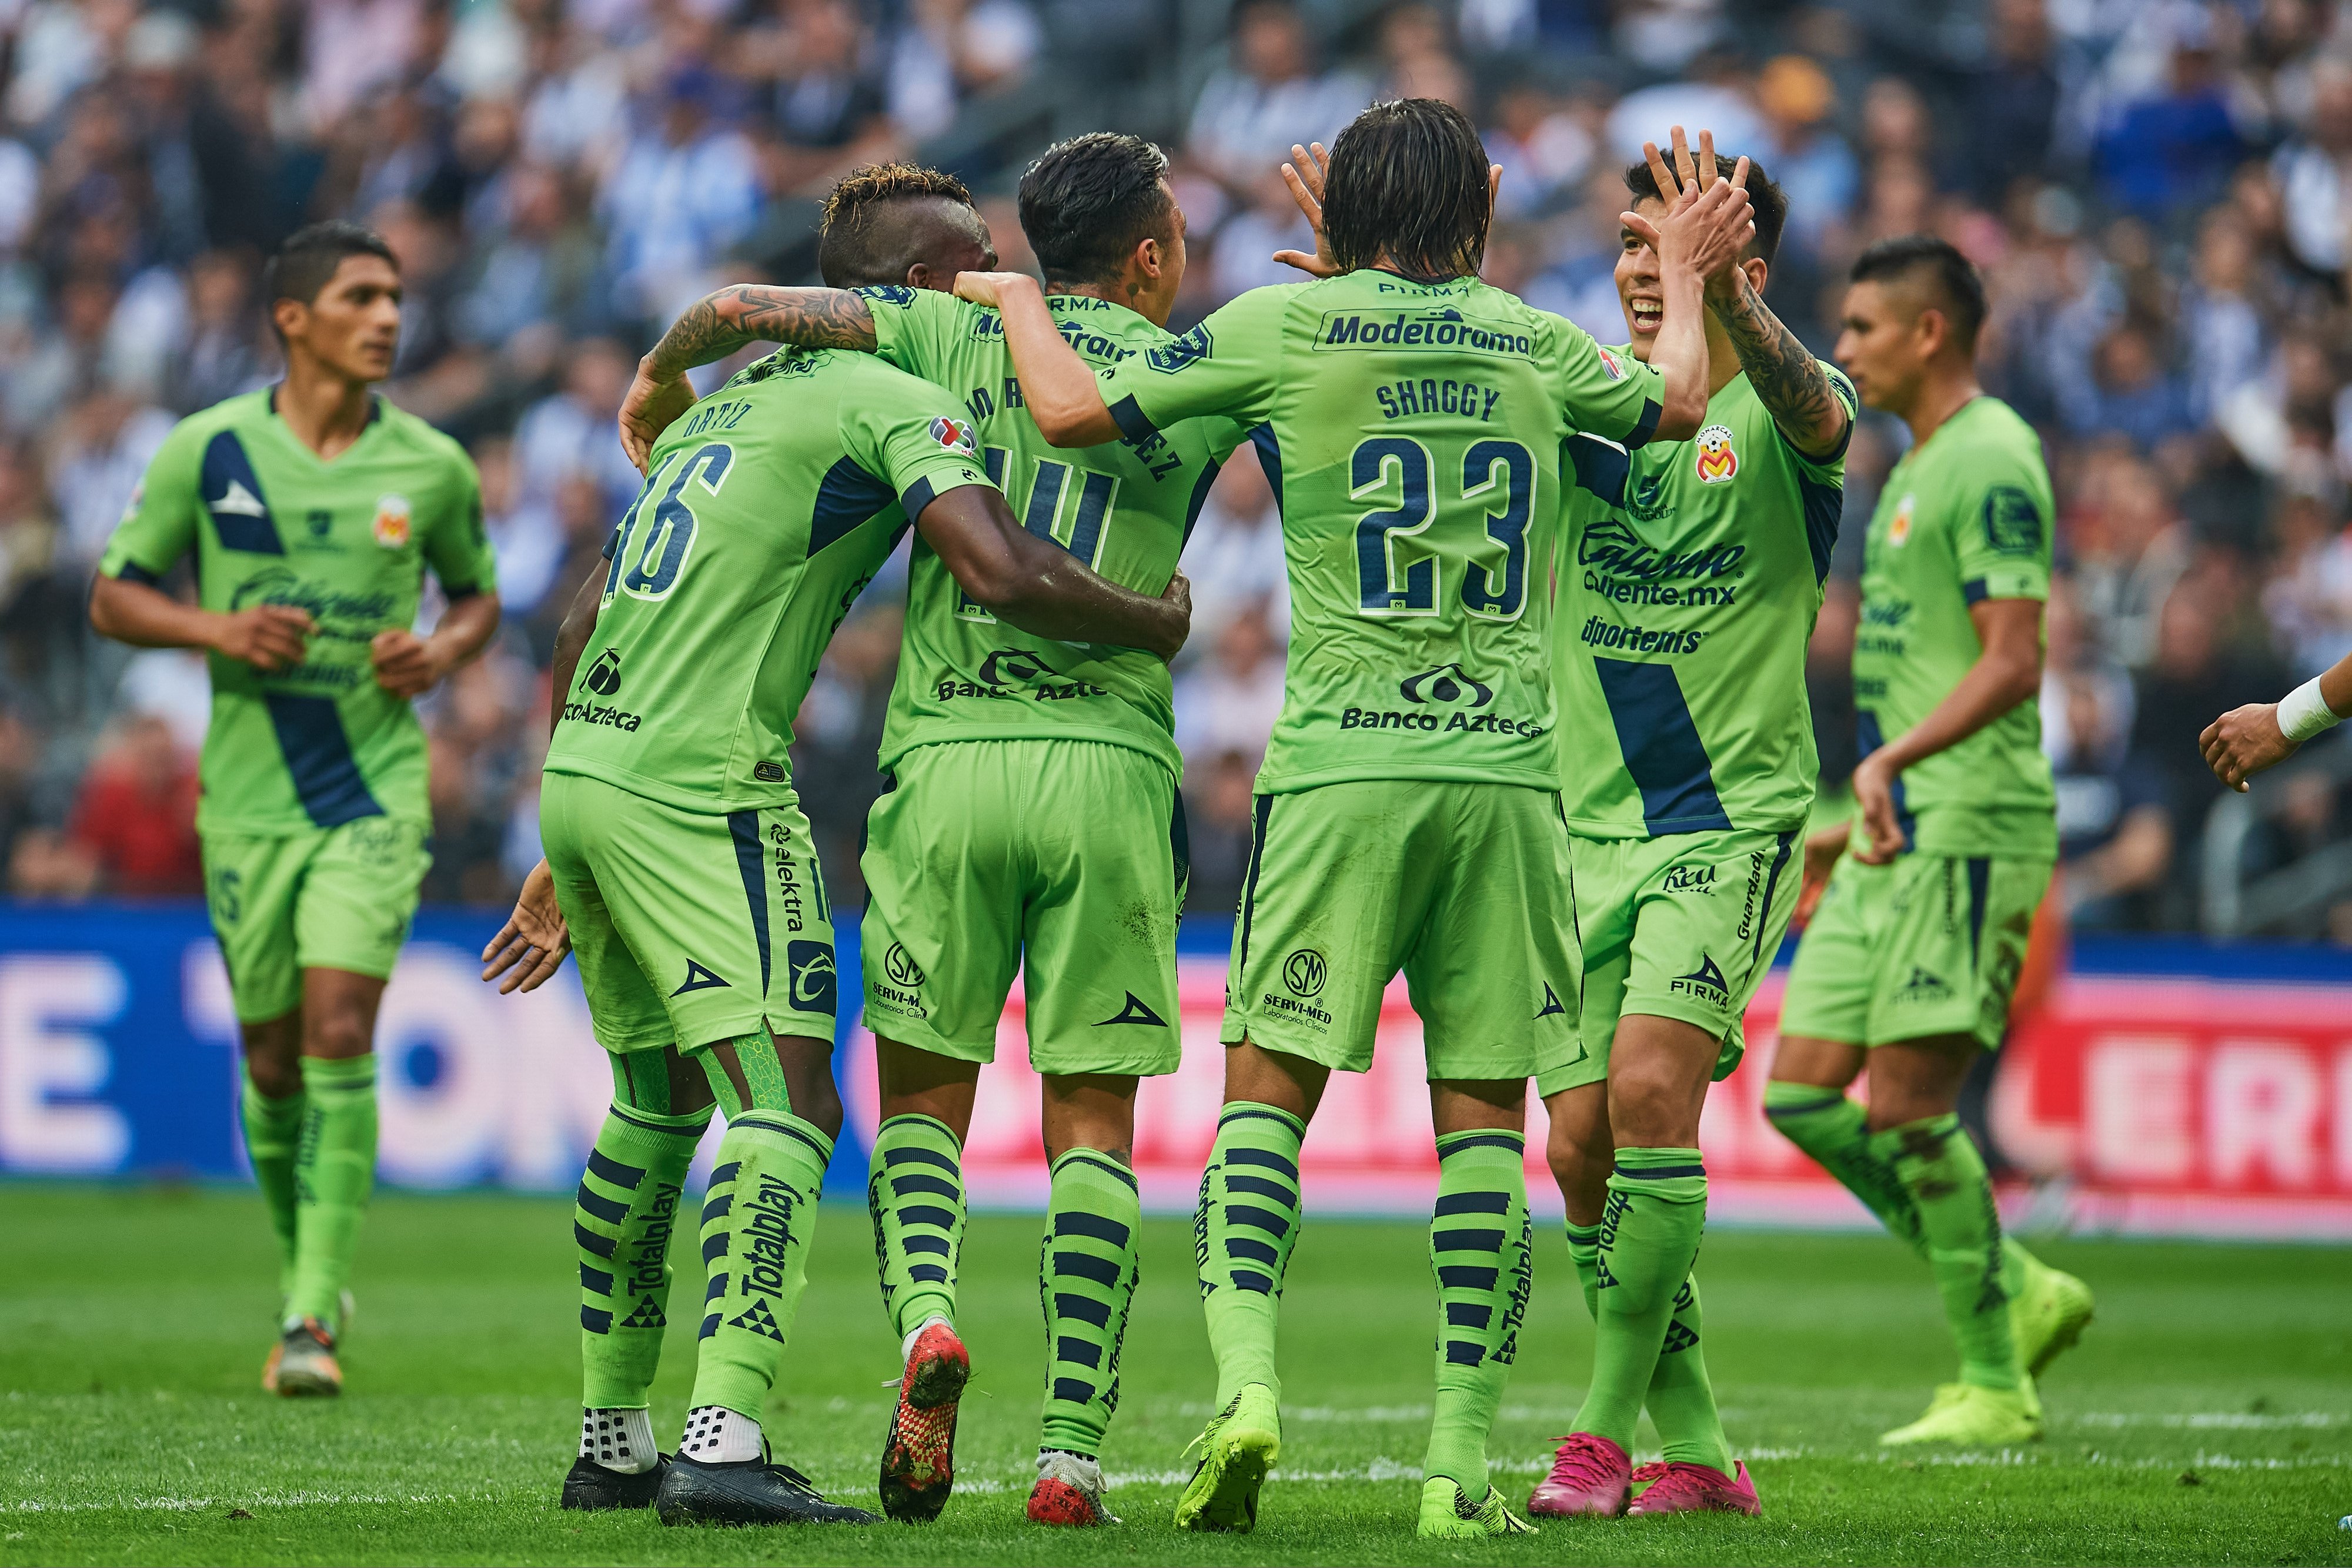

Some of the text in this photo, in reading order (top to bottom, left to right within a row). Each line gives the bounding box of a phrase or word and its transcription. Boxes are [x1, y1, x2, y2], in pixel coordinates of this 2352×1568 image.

[1050, 296, 1110, 312] RMA
[1379, 283, 1469, 297] PIRMA
[1325, 314, 1529, 355] Modelorama
[1377, 379, 1499, 422] SHAGGY
[1696, 426, 1732, 443] MONARCAS
[600, 442, 736, 610] 16
[1348, 434, 1538, 622] 23
[1581, 615, 1702, 654] dportenis
[1034, 682, 1108, 701] Azte
[1340, 707, 1544, 738] Banco Azteca
[776, 847, 803, 932] elektra
[1738, 848, 1766, 941] Guardadi
[1264, 993, 1332, 1025] SERVI-MED
[1671, 980, 1729, 1009] PIRMA
[1264, 1005, 1328, 1035] Laboratorios Clínicos
[627, 1181, 682, 1296] Totalplay
[741, 1173, 806, 1299] Totalplay
[1597, 1190, 1635, 1252] Totalp
